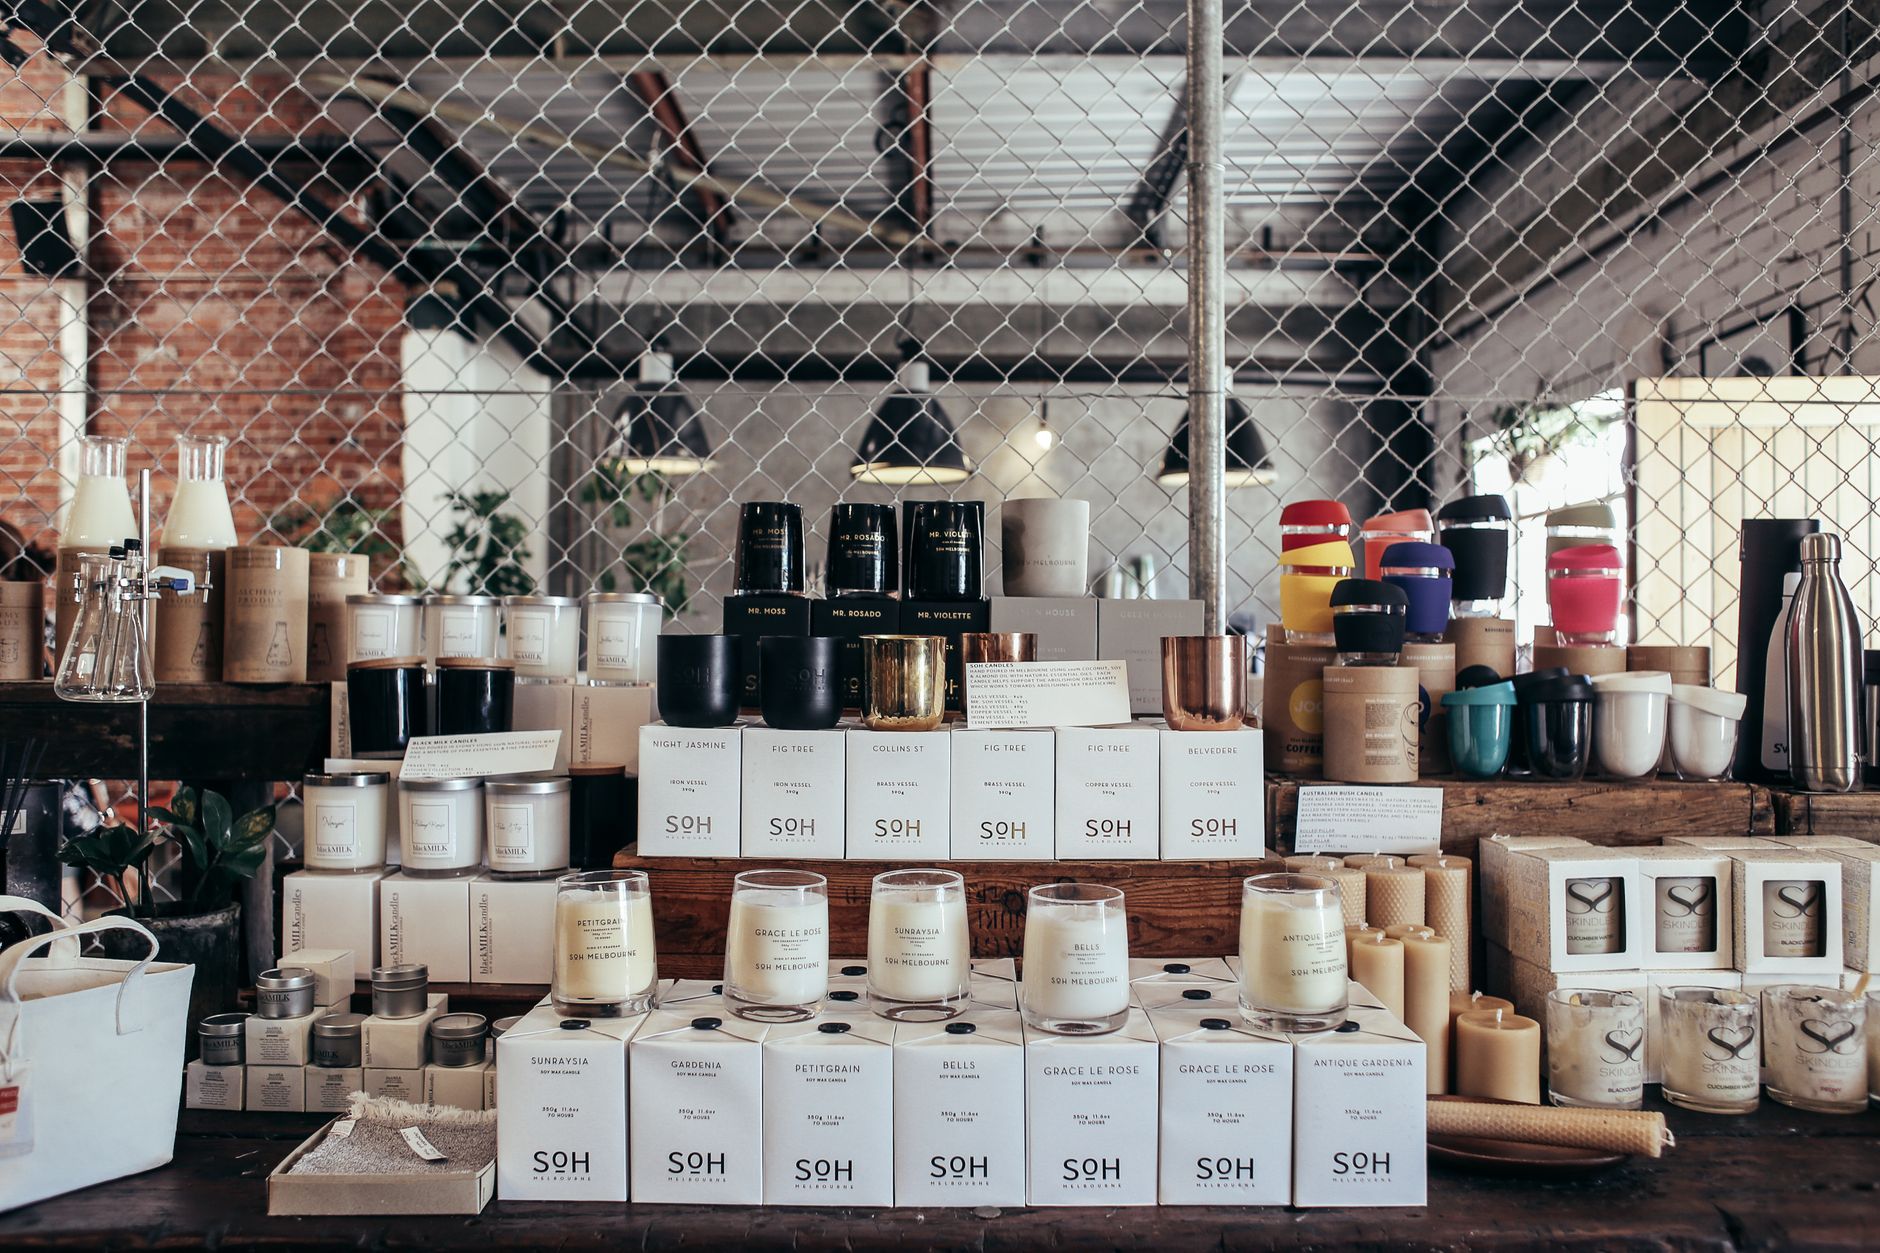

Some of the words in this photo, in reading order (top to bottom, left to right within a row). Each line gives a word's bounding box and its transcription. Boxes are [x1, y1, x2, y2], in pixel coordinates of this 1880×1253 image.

[854, 534, 885, 542] ROSADO
[748, 607, 762, 615] MR.
[764, 607, 786, 615] MOSS
[849, 610, 882, 618] ROSADO
[1045, 609, 1075, 617] HOUSE
[934, 612, 972, 620] VIOLETTE
[653, 740, 682, 749] NIGHT
[685, 741, 726, 750] JASMINE
[772, 745, 788, 753] FIG
[792, 745, 814, 753] TREE
[873, 745, 911, 753] COLLINS
[914, 745, 924, 753] ST
[984, 744, 1000, 752] FIG
[1004, 744, 1026, 752] TREE
[1087, 745, 1103, 753] FIG
[1107, 745, 1130, 753] TREE
[1188, 747, 1238, 755] BELVEDERE
[665, 815, 711, 834] SOH
[769, 818, 815, 837] SOH
[874, 819, 920, 838] SOH
[1085, 819, 1131, 838] SOH
[1191, 818, 1237, 837] SOH
[980, 821, 1026, 840] SOH
[412, 844, 448, 852] blackMILK
[755, 928, 786, 937] GRACE
[790, 929, 800, 937] LE
[804, 927, 821, 936] ROSE
[894, 927, 940, 935] SUNRAYSIA
[1282, 934, 1320, 942] ANTIQUE
[1074, 943, 1100, 951] BELLS
[587, 949, 637, 960] MELBOURNE
[775, 961, 819, 971] MELBOURNE
[902, 958, 949, 967] MELBOURNE
[1071, 975, 1118, 985] MELBOURNE
[531, 1056, 589, 1065] SUNRAYSIA
[671, 1060, 722, 1069] GARDENIA
[1314, 1059, 1358, 1068] ANTIQUE
[1362, 1059, 1413, 1067] GARDENIA
[795, 1064, 860, 1073] PETITGRAIN
[943, 1061, 976, 1070] BELLS
[1179, 1064, 1220, 1074] GRACE
[1225, 1064, 1238, 1074] LE
[1244, 1064, 1275, 1074] ROSE
[1043, 1066, 1084, 1076] GRACE
[1090, 1066, 1103, 1075] LE
[1108, 1065, 1139, 1075] ROSE
[533, 1151, 590, 1173] SOH
[668, 1151, 725, 1174] SOH
[1333, 1152, 1390, 1175] SOH
[795, 1159, 852, 1181] SOH
[930, 1156, 988, 1178] SOH
[1062, 1158, 1120, 1181] SOH
[1196, 1157, 1254, 1180] SOH
